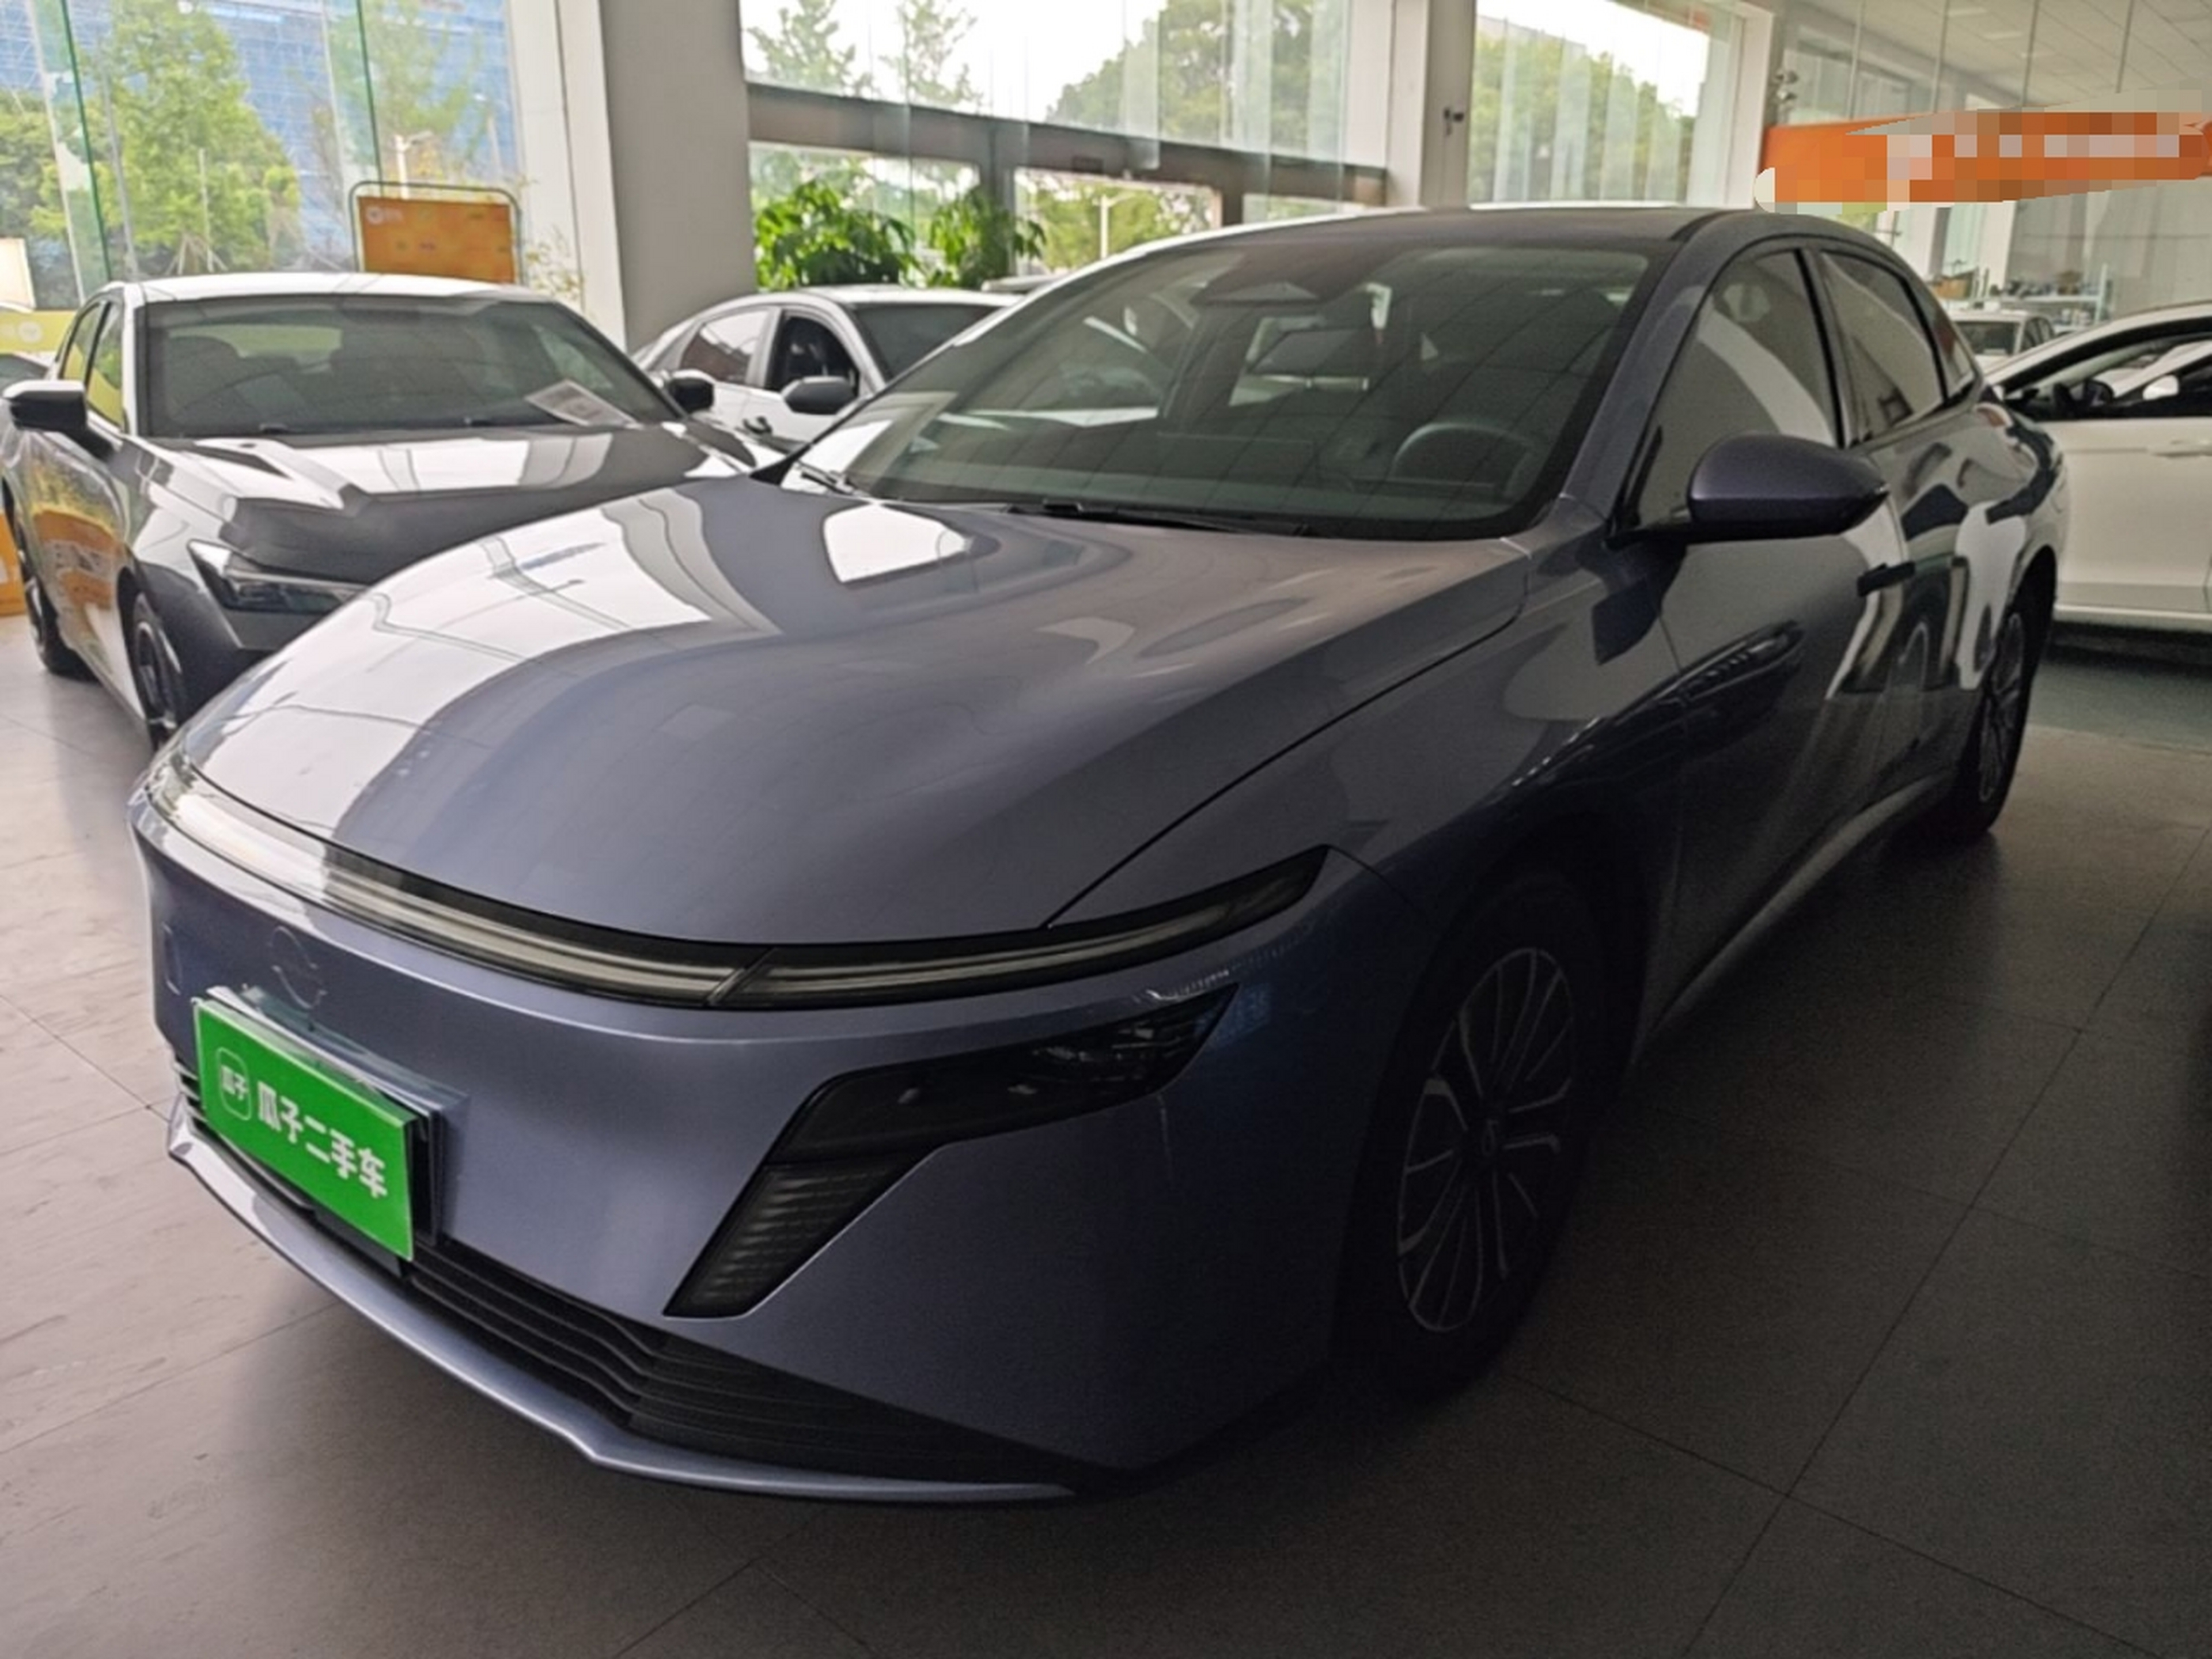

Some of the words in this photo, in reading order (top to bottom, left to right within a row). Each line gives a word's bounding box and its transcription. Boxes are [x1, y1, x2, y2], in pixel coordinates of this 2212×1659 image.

[257, 1080, 388, 1199] 瓜子二手车
